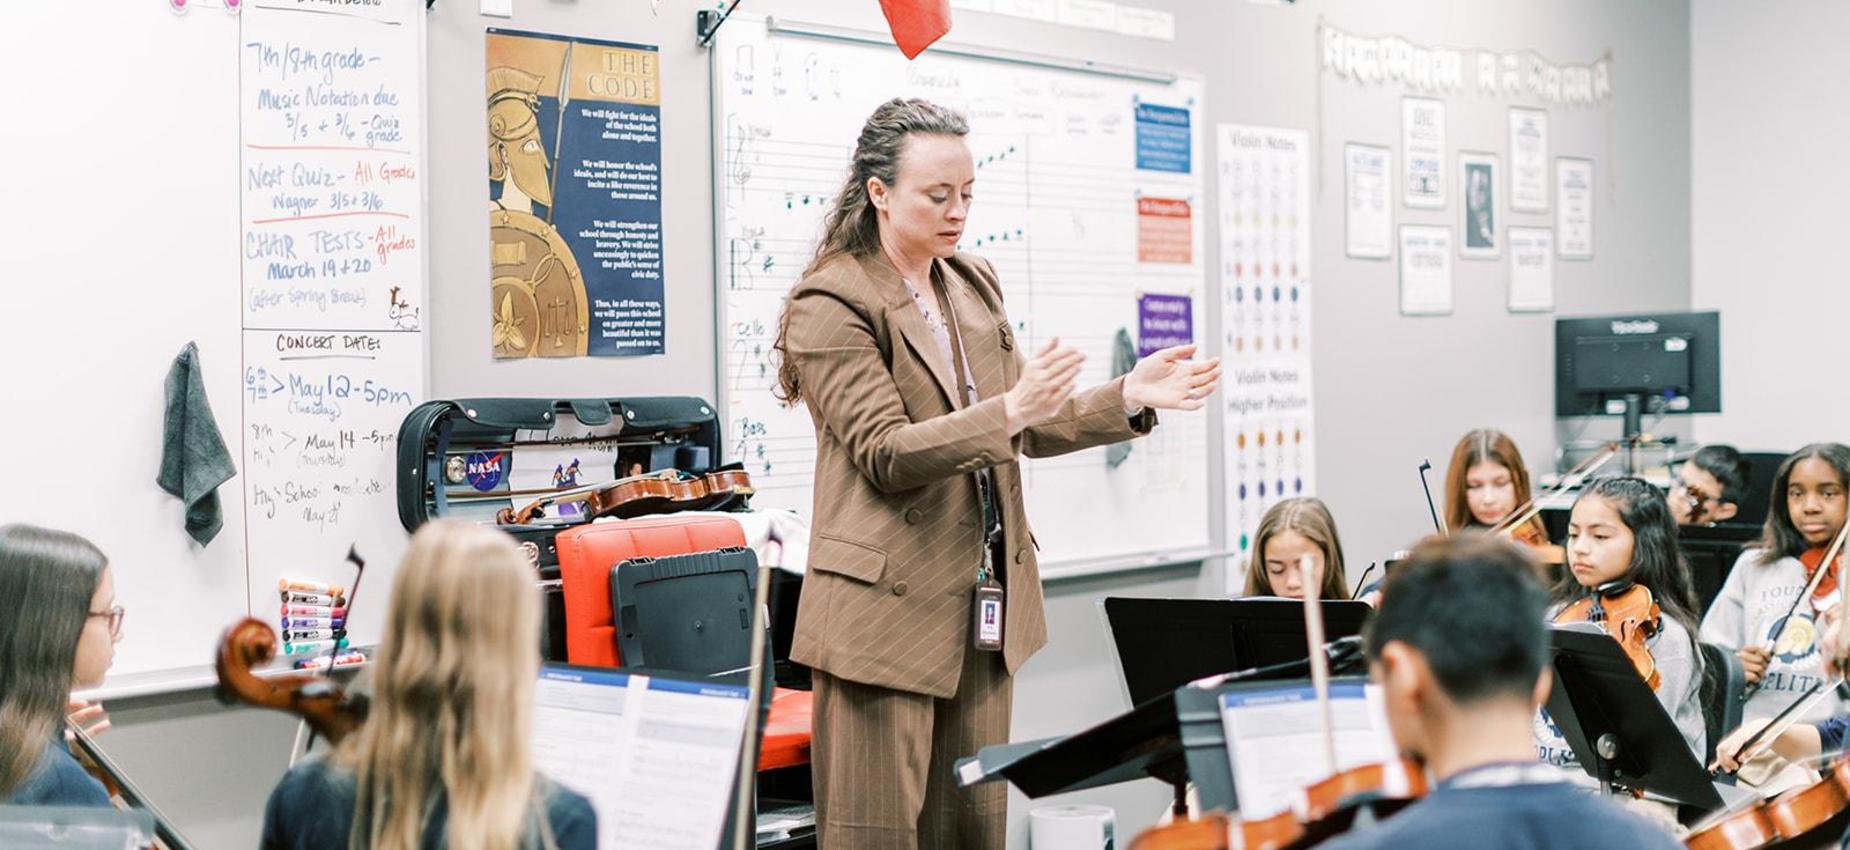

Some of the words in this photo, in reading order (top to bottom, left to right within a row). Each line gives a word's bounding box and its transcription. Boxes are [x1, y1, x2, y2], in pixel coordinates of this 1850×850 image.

[605, 52, 652, 75] THE
[588, 74, 653, 99] CODE
[258, 88, 300, 110] Music
[305, 83, 369, 107] Notation
[373, 84, 399, 106] due
[592, 109, 604, 118] will
[613, 121, 623, 129] the
[624, 122, 642, 131] school
[620, 132, 631, 140] and
[593, 160, 605, 169] will
[606, 161, 624, 169] honor
[625, 161, 635, 170] the
[248, 164, 284, 191] Next
[354, 160, 373, 185] All
[594, 170, 607, 178] and
[607, 171, 619, 179] will
[611, 180, 623, 189] like
[647, 232, 658, 240] and
[246, 231, 298, 260] CHAIR
[308, 230, 364, 254] TESTS
[377, 240, 416, 265] grades
[631, 241, 643, 249] will
[267, 261, 315, 280] March
[322, 259, 336, 278] 19
[352, 258, 372, 274] 20
[642, 309, 661, 317] school
[634, 319, 645, 327] and
[276, 334, 335, 352] CONCERT
[289, 374, 324, 406] May
[305, 434, 335, 454] May
[340, 429, 355, 450] 14
[469, 461, 500, 474] NASA
[285, 481, 320, 504] Schoo
